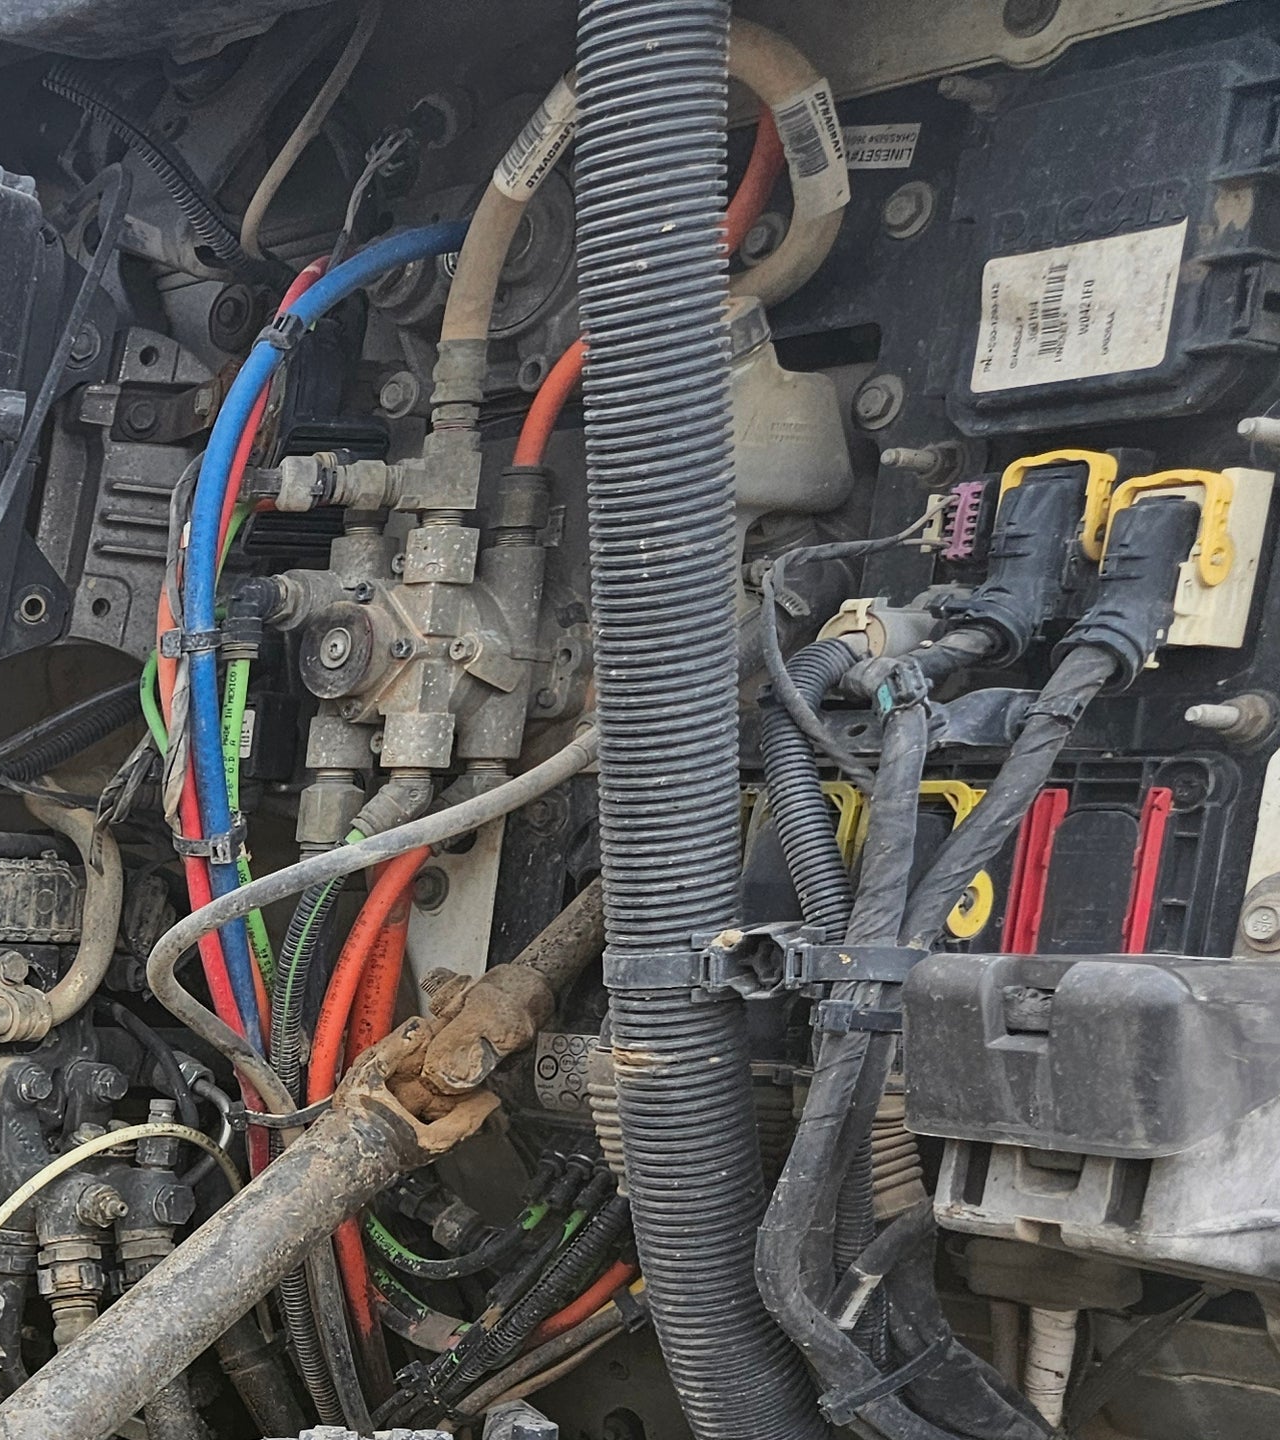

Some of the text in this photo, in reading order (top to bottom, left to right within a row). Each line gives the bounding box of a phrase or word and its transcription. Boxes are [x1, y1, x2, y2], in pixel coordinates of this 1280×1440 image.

[990, 179, 1189, 252] PACCAR
[223, 724, 231, 746] MADE
[227, 671, 238, 704] MEXICO
